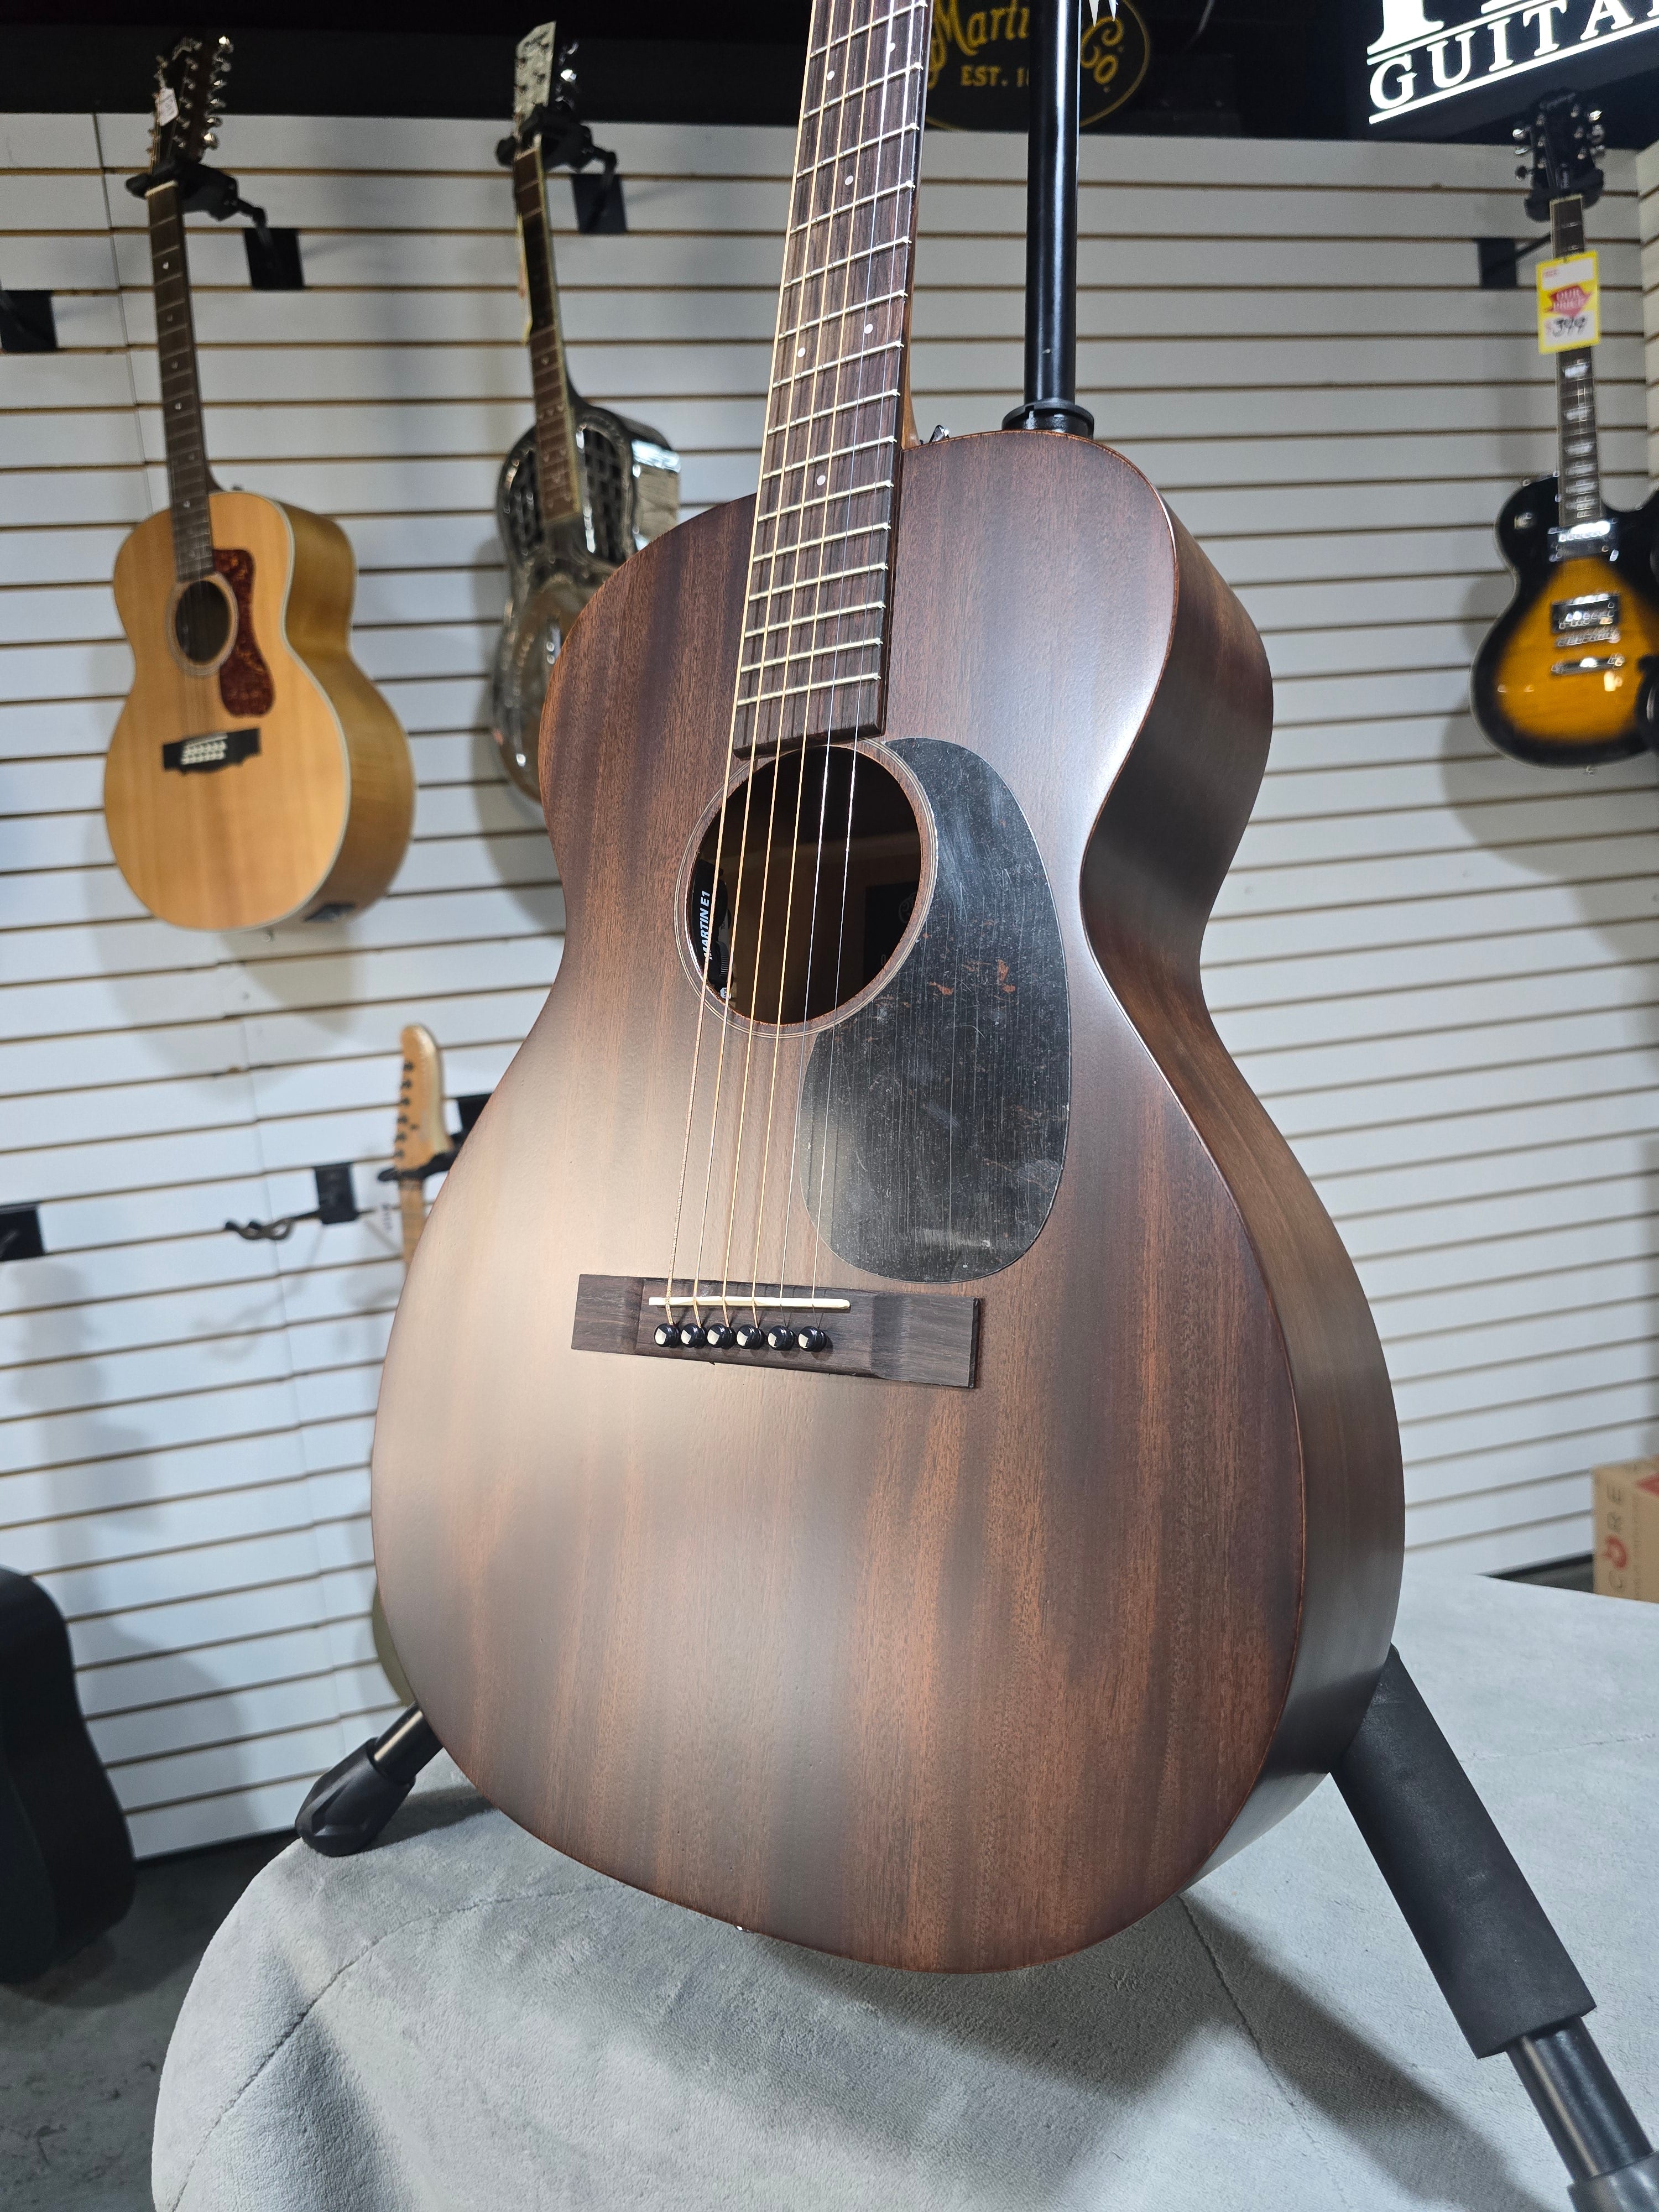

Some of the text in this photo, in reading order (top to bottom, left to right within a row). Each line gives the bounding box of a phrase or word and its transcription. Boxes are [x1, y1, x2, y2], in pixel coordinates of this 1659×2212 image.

[1369, 0, 1659, 109] GUITA
[960, 65, 1009, 87] EST.
[701, 890, 711, 907] E1
